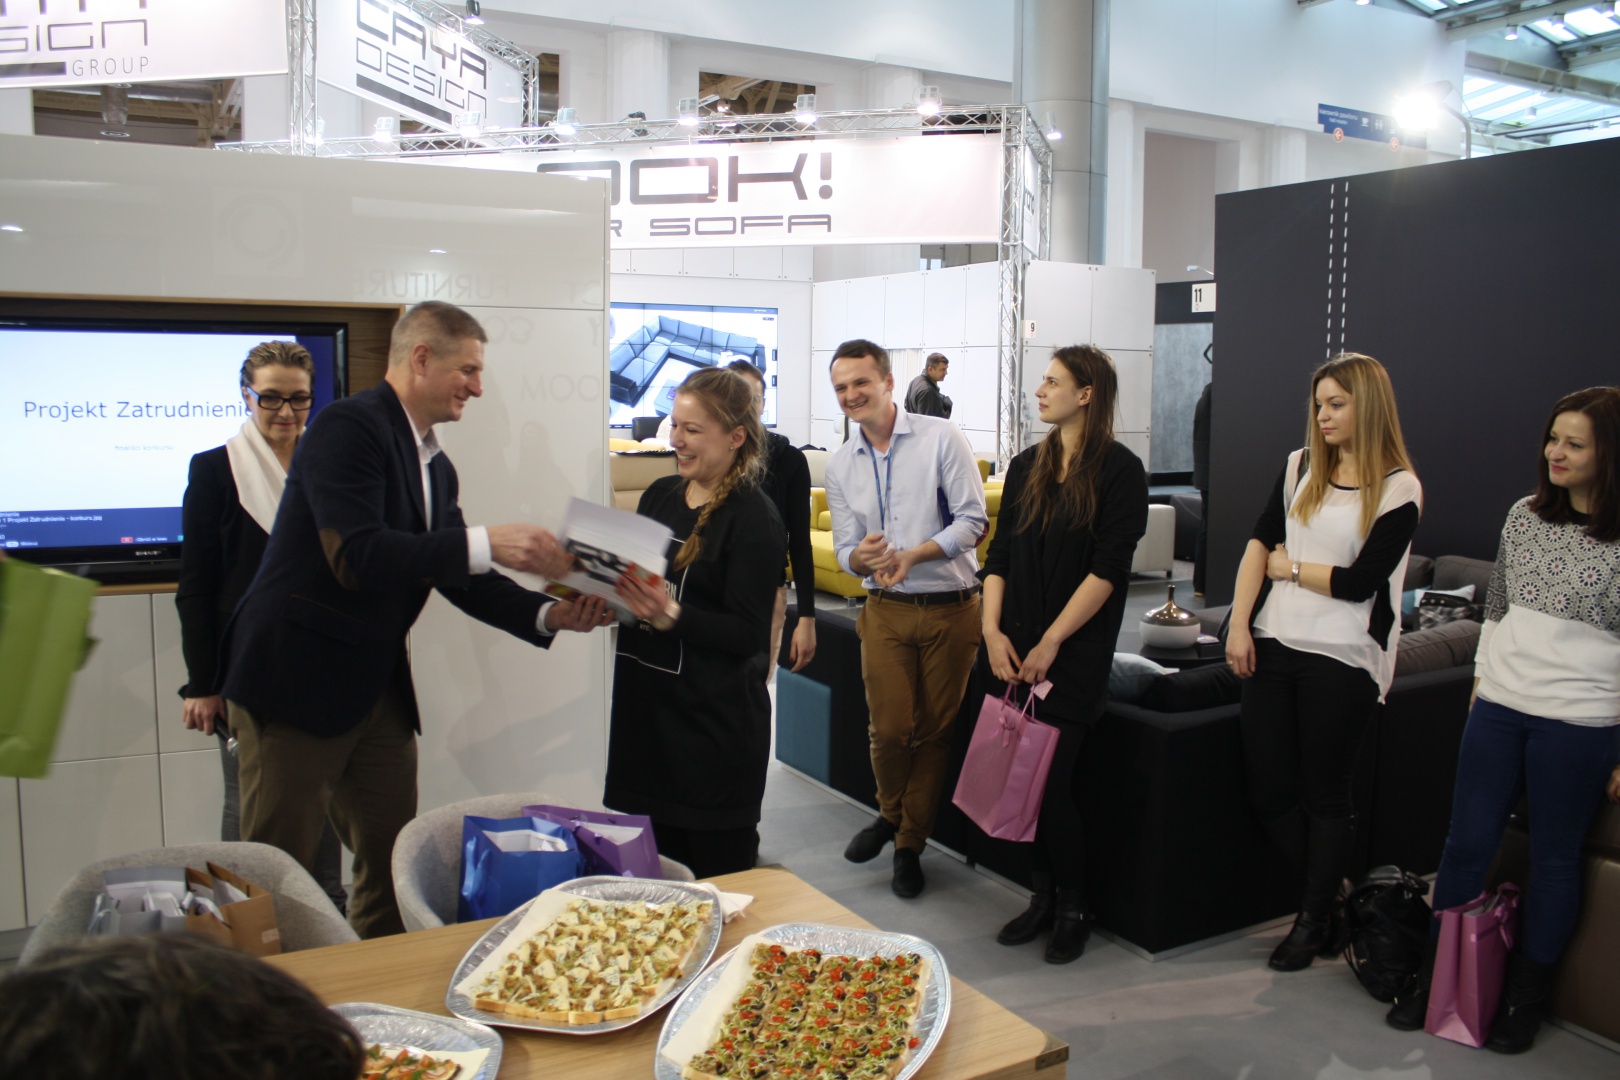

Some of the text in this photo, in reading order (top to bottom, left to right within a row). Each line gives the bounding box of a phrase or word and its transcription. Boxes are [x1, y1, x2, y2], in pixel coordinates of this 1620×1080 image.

[356, 0, 487, 90] CAYA
[72, 56, 149, 77] GROUP
[356, 37, 487, 120] DESIGN
[649, 213, 832, 236] SOFA
[1193, 287, 1203, 303] 11
[1030, 322, 1036, 333] 9
[23, 401, 108, 423] Projekt
